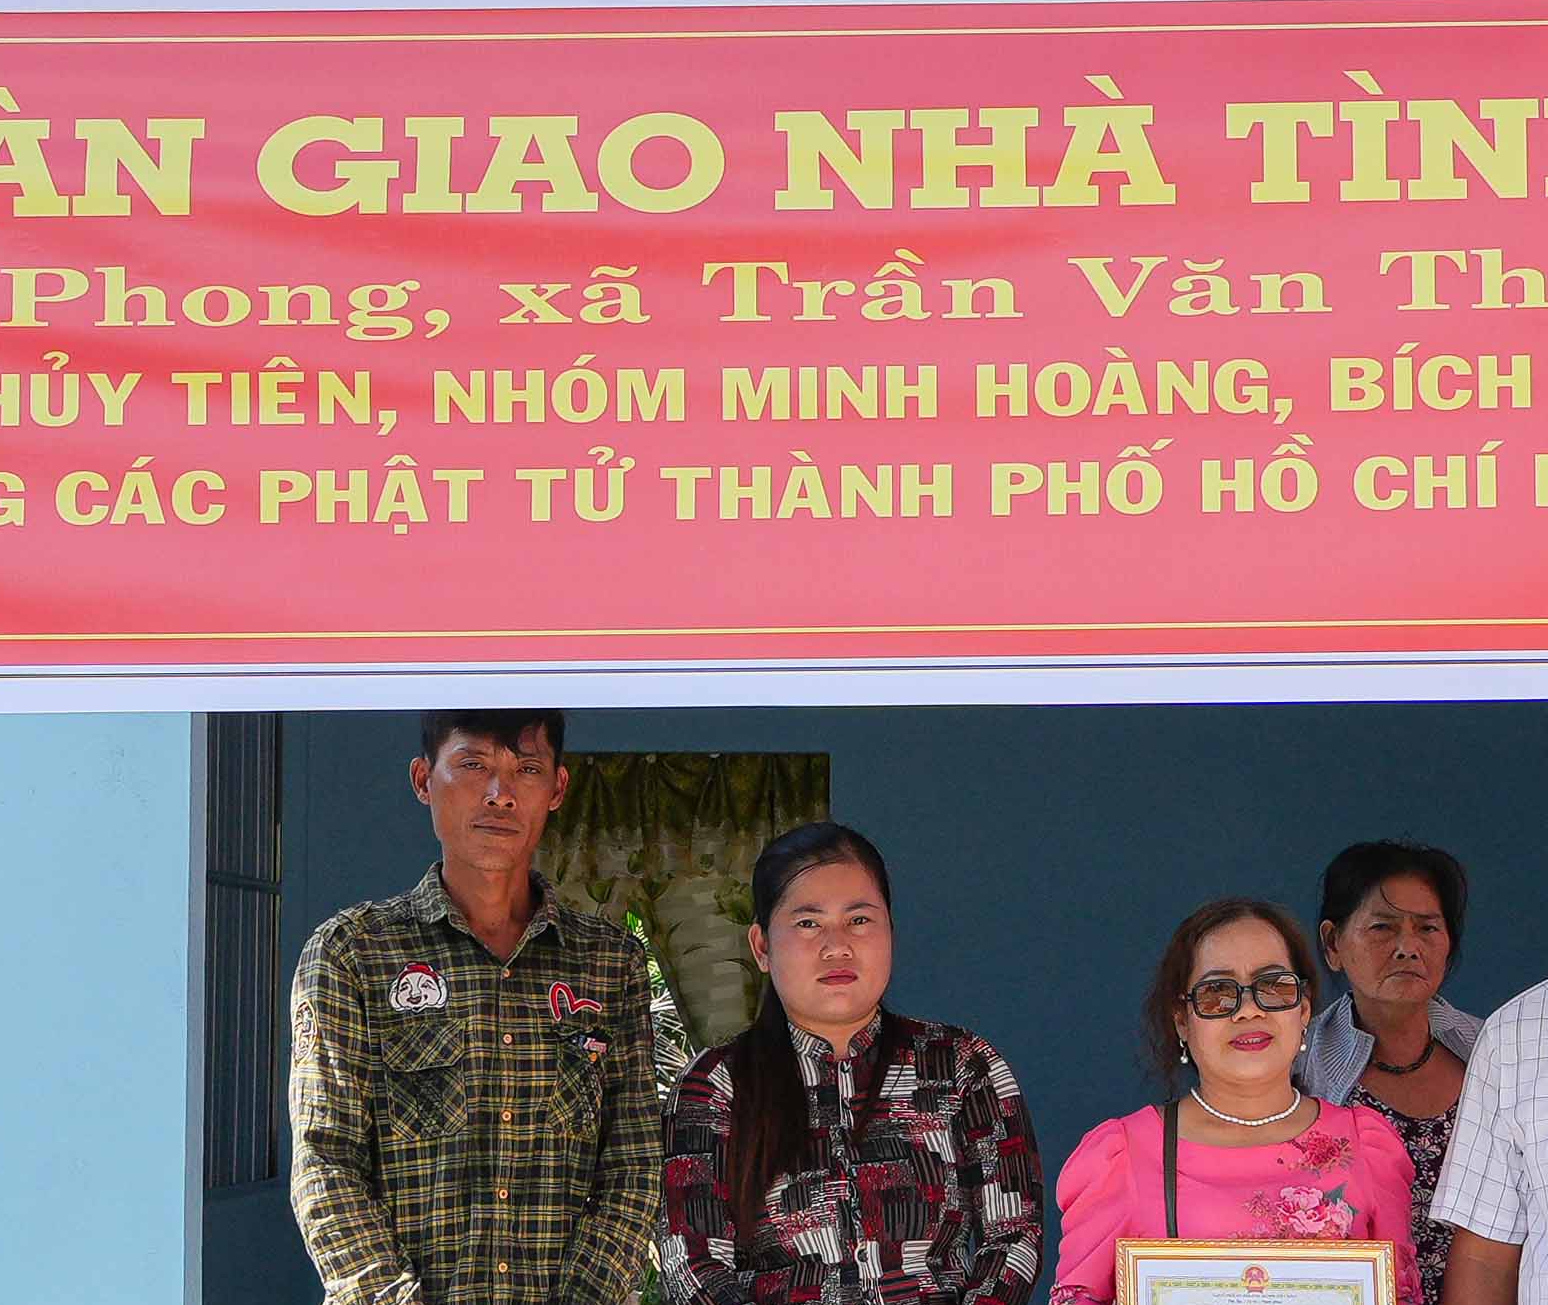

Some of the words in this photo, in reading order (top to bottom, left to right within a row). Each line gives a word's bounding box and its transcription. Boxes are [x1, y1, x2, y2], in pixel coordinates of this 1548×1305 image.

[257, 111, 727, 218] GIAO
[774, 74, 1179, 211] NHÀ
[499, 263, 653, 326] xã
[698, 246, 1020, 323] Trần
[1065, 254, 1336, 318] Văn
[170, 354, 399, 437] TIÊN,
[433, 352, 687, 425] NHÓM
[721, 363, 940, 423] MINH
[974, 345, 1295, 425] HOÀNG,
[1329, 340, 1534, 413] BÍCH
[55, 455, 228, 527] CÁC
[257, 452, 487, 537] PHẬT
[514, 444, 637, 523] TỬ
[660, 448, 955, 521] THÀNH
[990, 436, 1170, 518] PHỐ
[1201, 431, 1321, 513] HỒ
[1353, 440, 1501, 511] CHÍ
